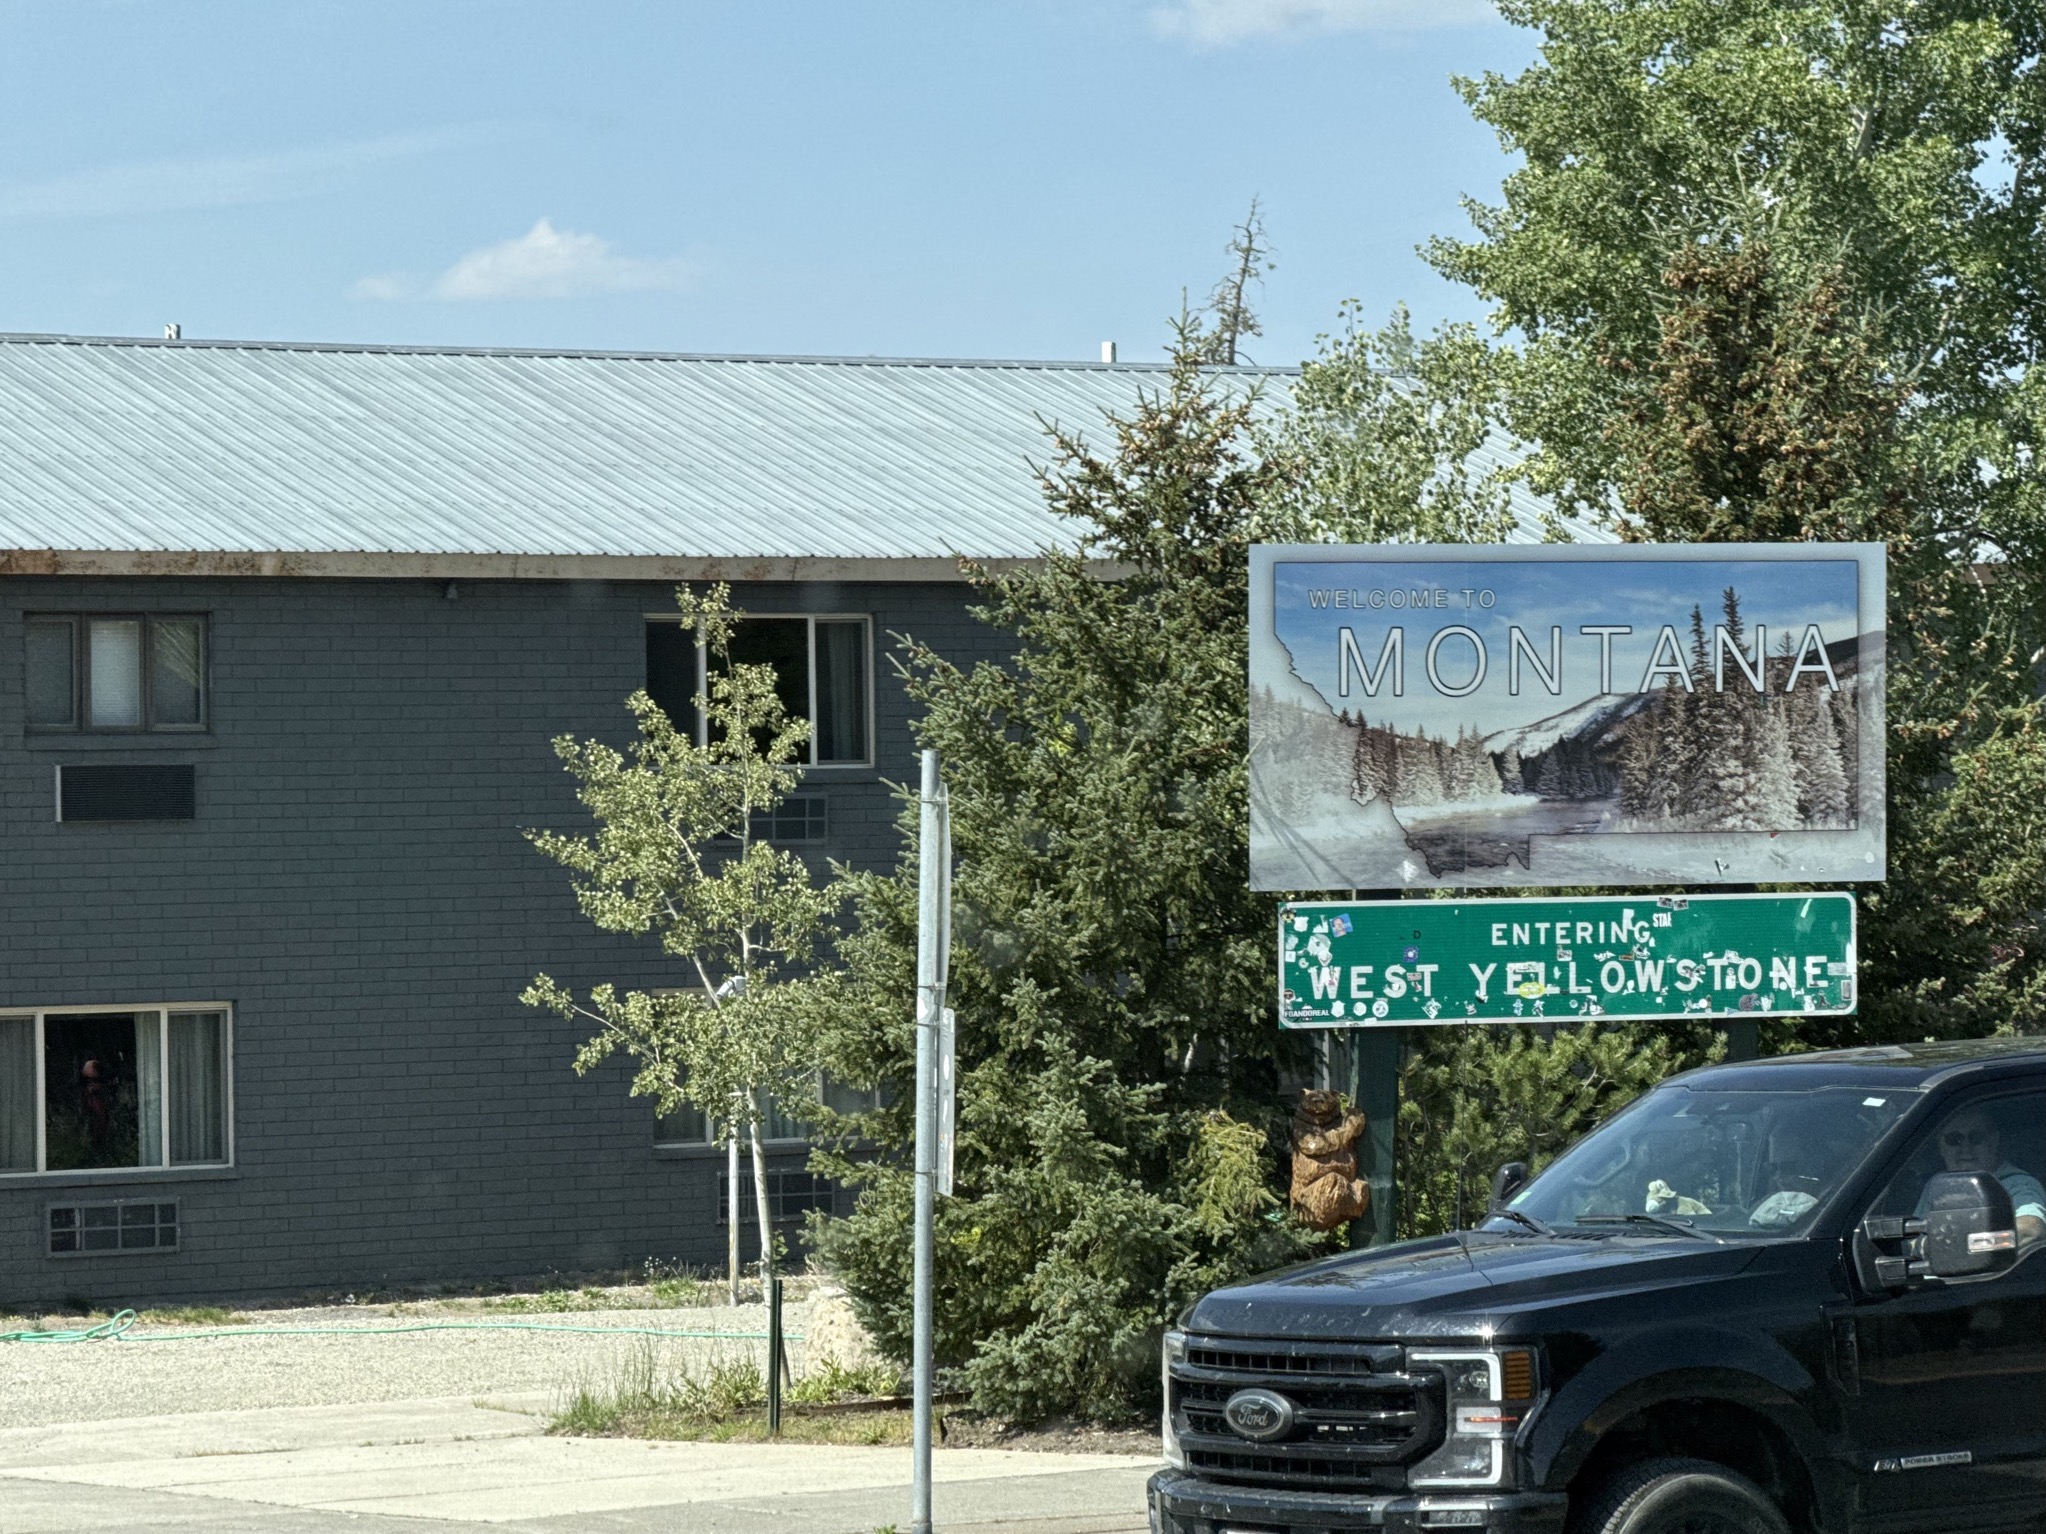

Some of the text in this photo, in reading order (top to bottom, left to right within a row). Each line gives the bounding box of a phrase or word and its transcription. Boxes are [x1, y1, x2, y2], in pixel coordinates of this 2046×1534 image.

[1308, 589, 1496, 609] WELCOME TO
[1338, 624, 1841, 698] MONTANA
[1491, 920, 1651, 946] ENTERING
[1309, 964, 1439, 1000] WEST
[1468, 955, 1829, 997] YELLOWSTONE
[1238, 1403, 1269, 1426] Ford
[1904, 1455, 1934, 1466] POWER
[1935, 1452, 1970, 1462] STROKE
